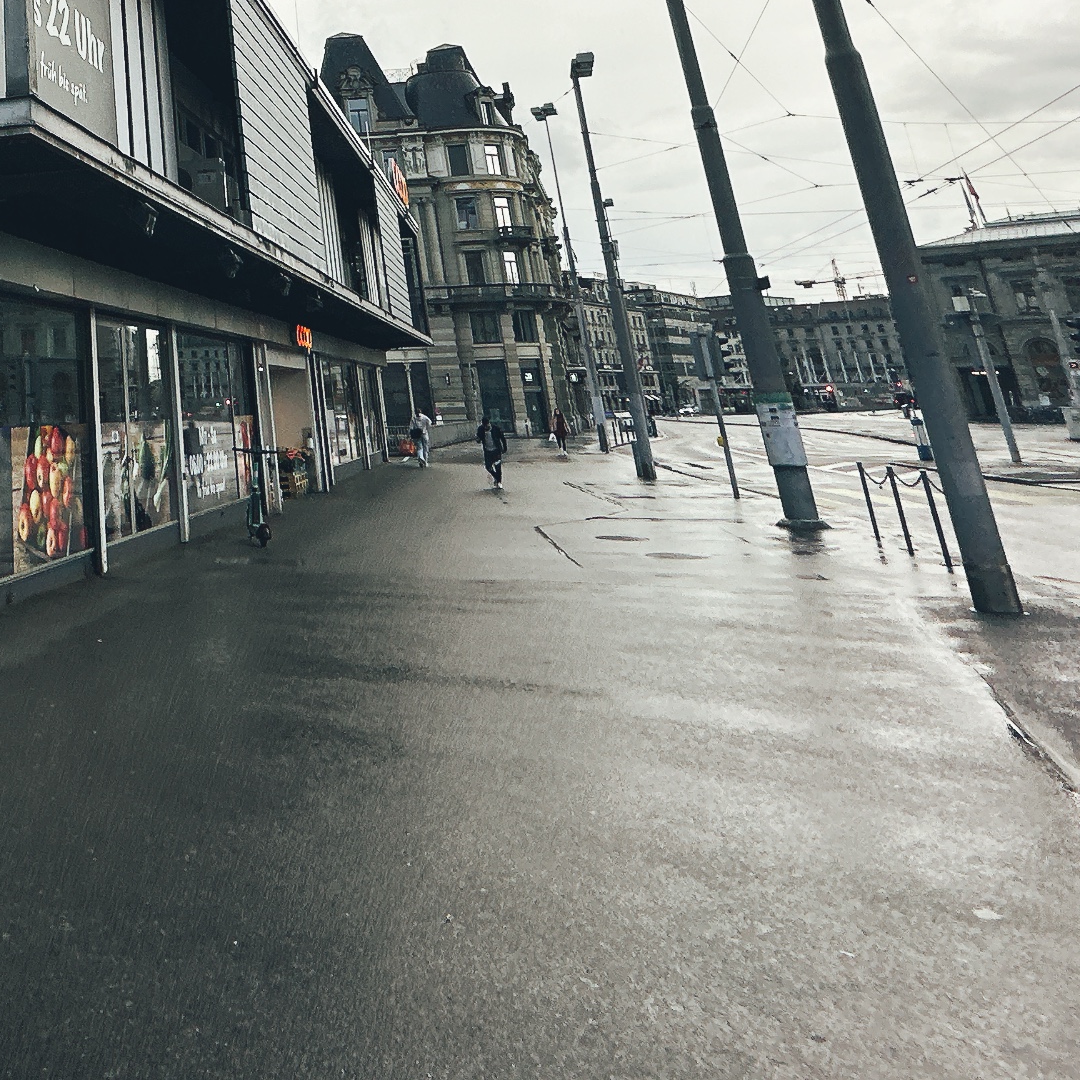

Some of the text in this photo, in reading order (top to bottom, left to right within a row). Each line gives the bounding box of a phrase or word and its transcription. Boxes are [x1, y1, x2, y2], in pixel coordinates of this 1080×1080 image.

[74, 8, 105, 73] Uhr
[39, 50, 57, 83] früh
[58, 65, 69, 91] bis
